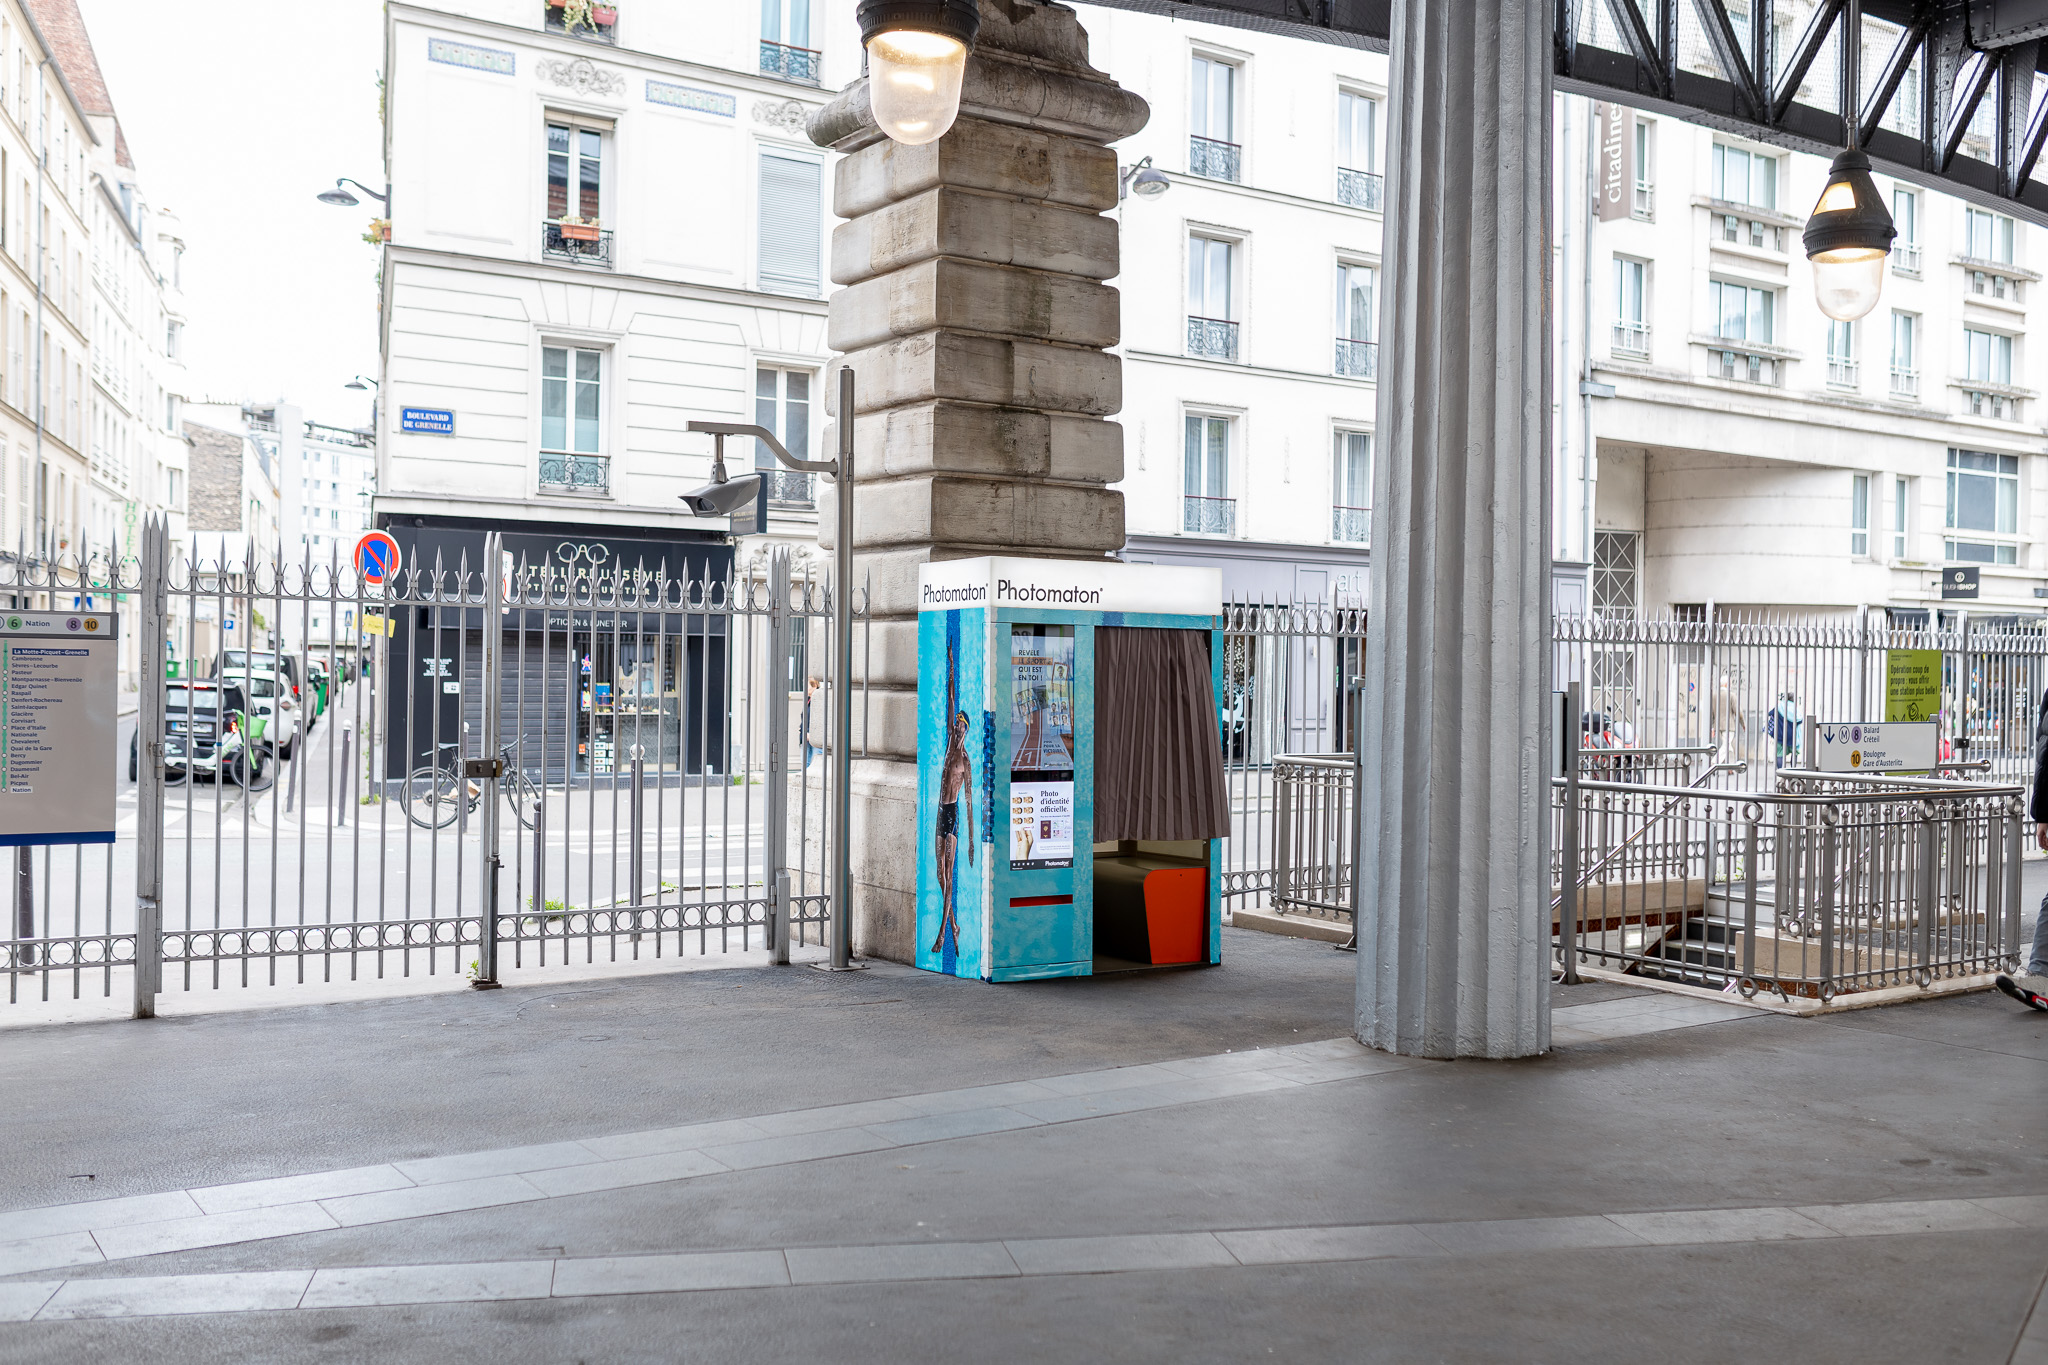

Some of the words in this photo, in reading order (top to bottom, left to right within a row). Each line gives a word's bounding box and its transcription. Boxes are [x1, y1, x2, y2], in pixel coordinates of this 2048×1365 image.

[407, 411, 449, 421] BOULEVARD
[404, 420, 413, 428] DE
[415, 421, 452, 431] GRENELLE
[1337, 570, 1361, 592] art
[924, 584, 987, 603] Photomaton
[998, 579, 1101, 604] Photomaton
[70, 621, 77, 629] 8
[85, 621, 97, 629] 10
[1891, 664, 1912, 675] Opération
[1913, 666, 1923, 676] coup
[1924, 664, 1929, 673] de
[1890, 677, 1905, 686] propre
[1900, 686, 1915, 695] station
[1916, 686, 1924, 697] plus
[1854, 730, 1859, 740] 8
[1863, 735, 1880, 743] Créteil
[1852, 754, 1860, 764] 10
[1863, 750, 1886, 758] Boulogne
[1876, 759, 1903, 767] d'Austerlitz
